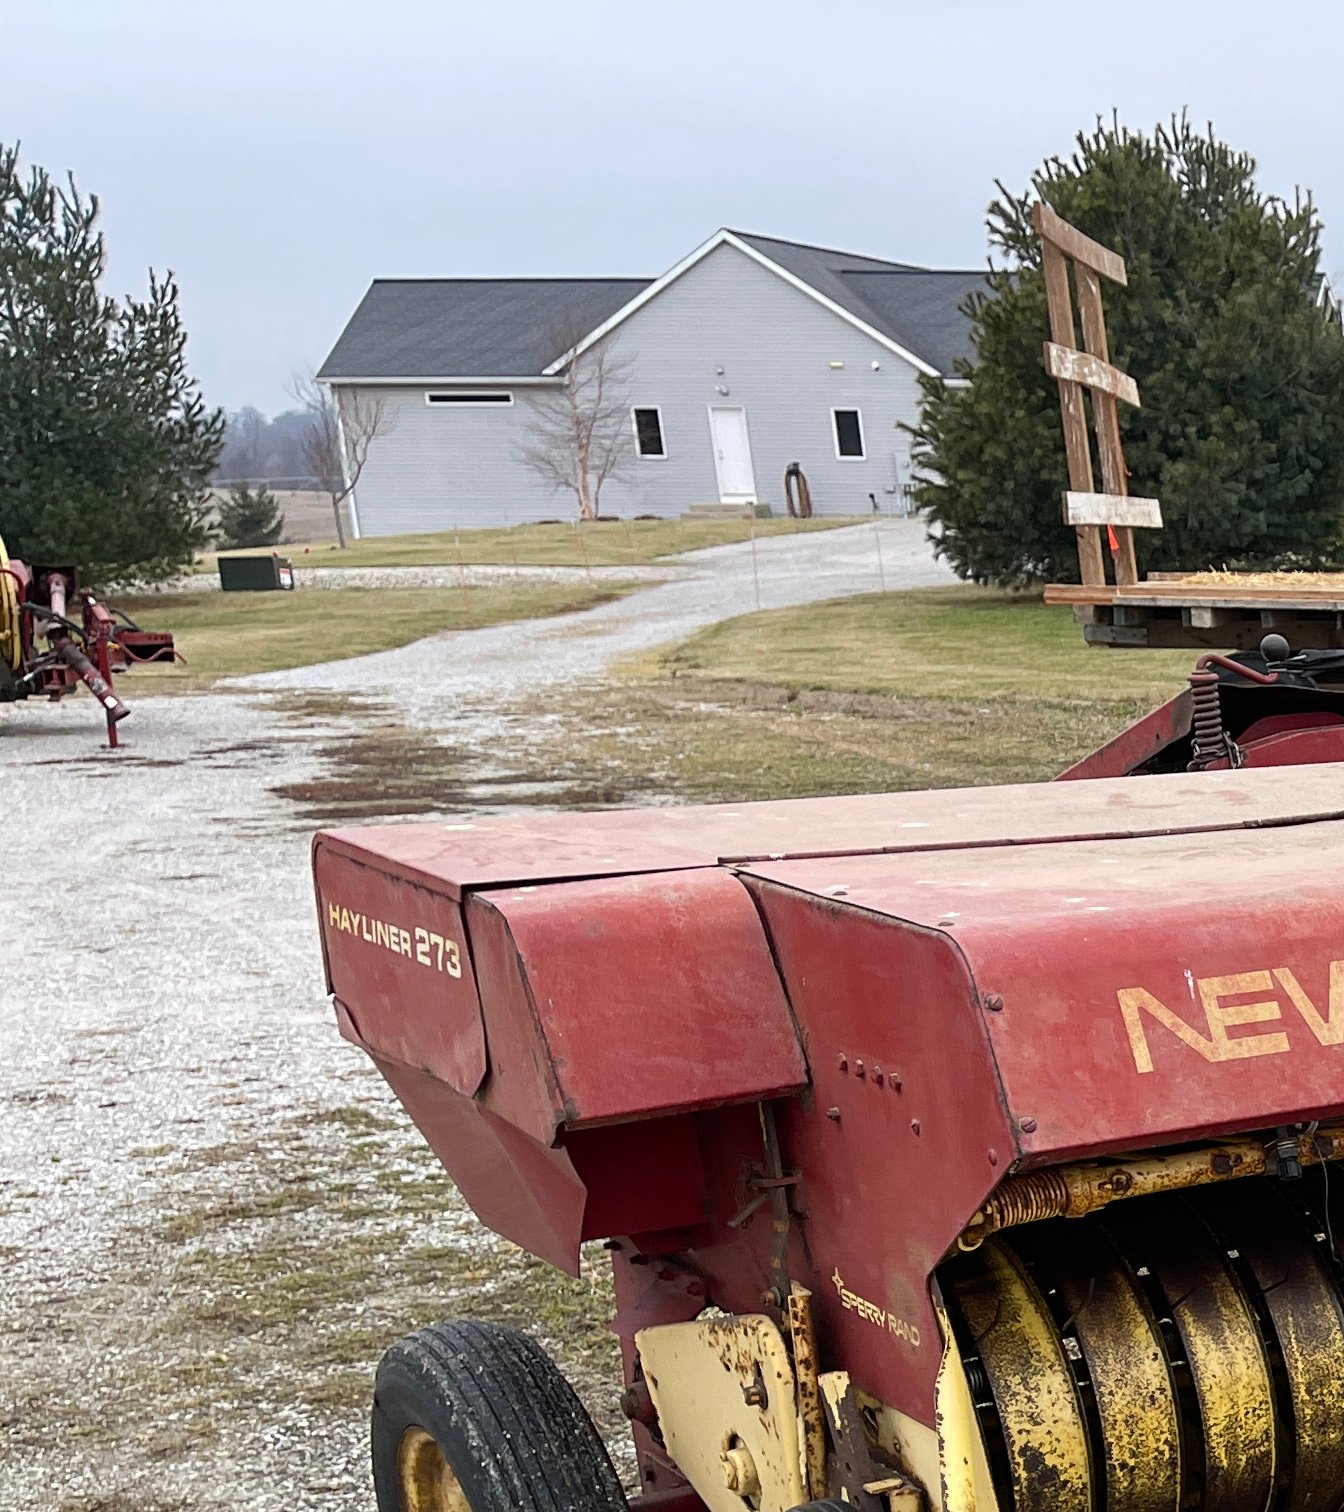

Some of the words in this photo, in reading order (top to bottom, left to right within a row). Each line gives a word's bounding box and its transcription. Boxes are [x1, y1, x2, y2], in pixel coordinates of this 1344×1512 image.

[328, 903, 412, 958] HAYLINER
[414, 927, 462, 979] 273
[841, 1288, 885, 1328] SPERRY
[888, 1314, 920, 1347] RAND
